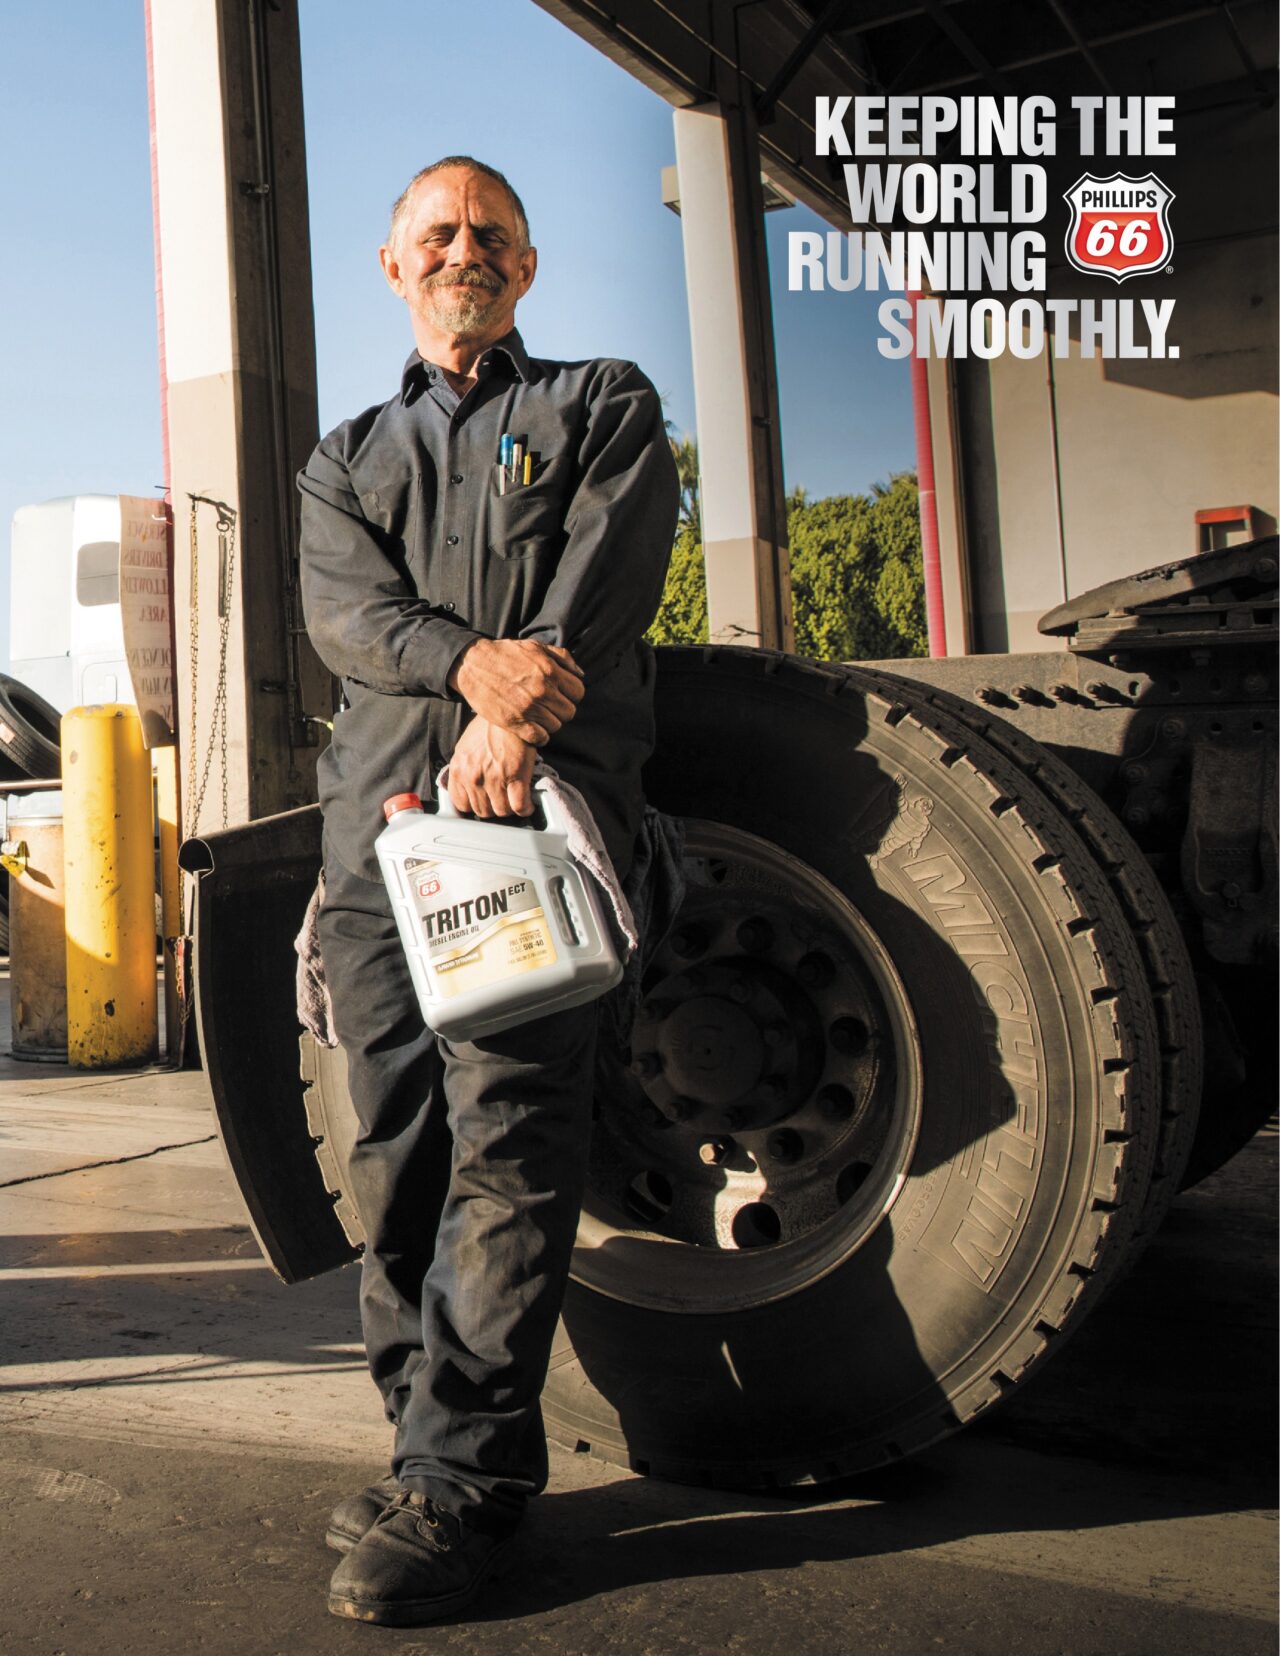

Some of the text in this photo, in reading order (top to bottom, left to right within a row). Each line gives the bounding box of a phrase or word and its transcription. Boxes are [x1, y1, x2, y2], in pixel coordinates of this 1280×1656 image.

[421, 880, 439, 895] 66
[422, 883, 526, 939] TRITON ECT
[448, 928, 469, 941] ENGINE
[902, 853, 1040, 1284] MICHELIN
